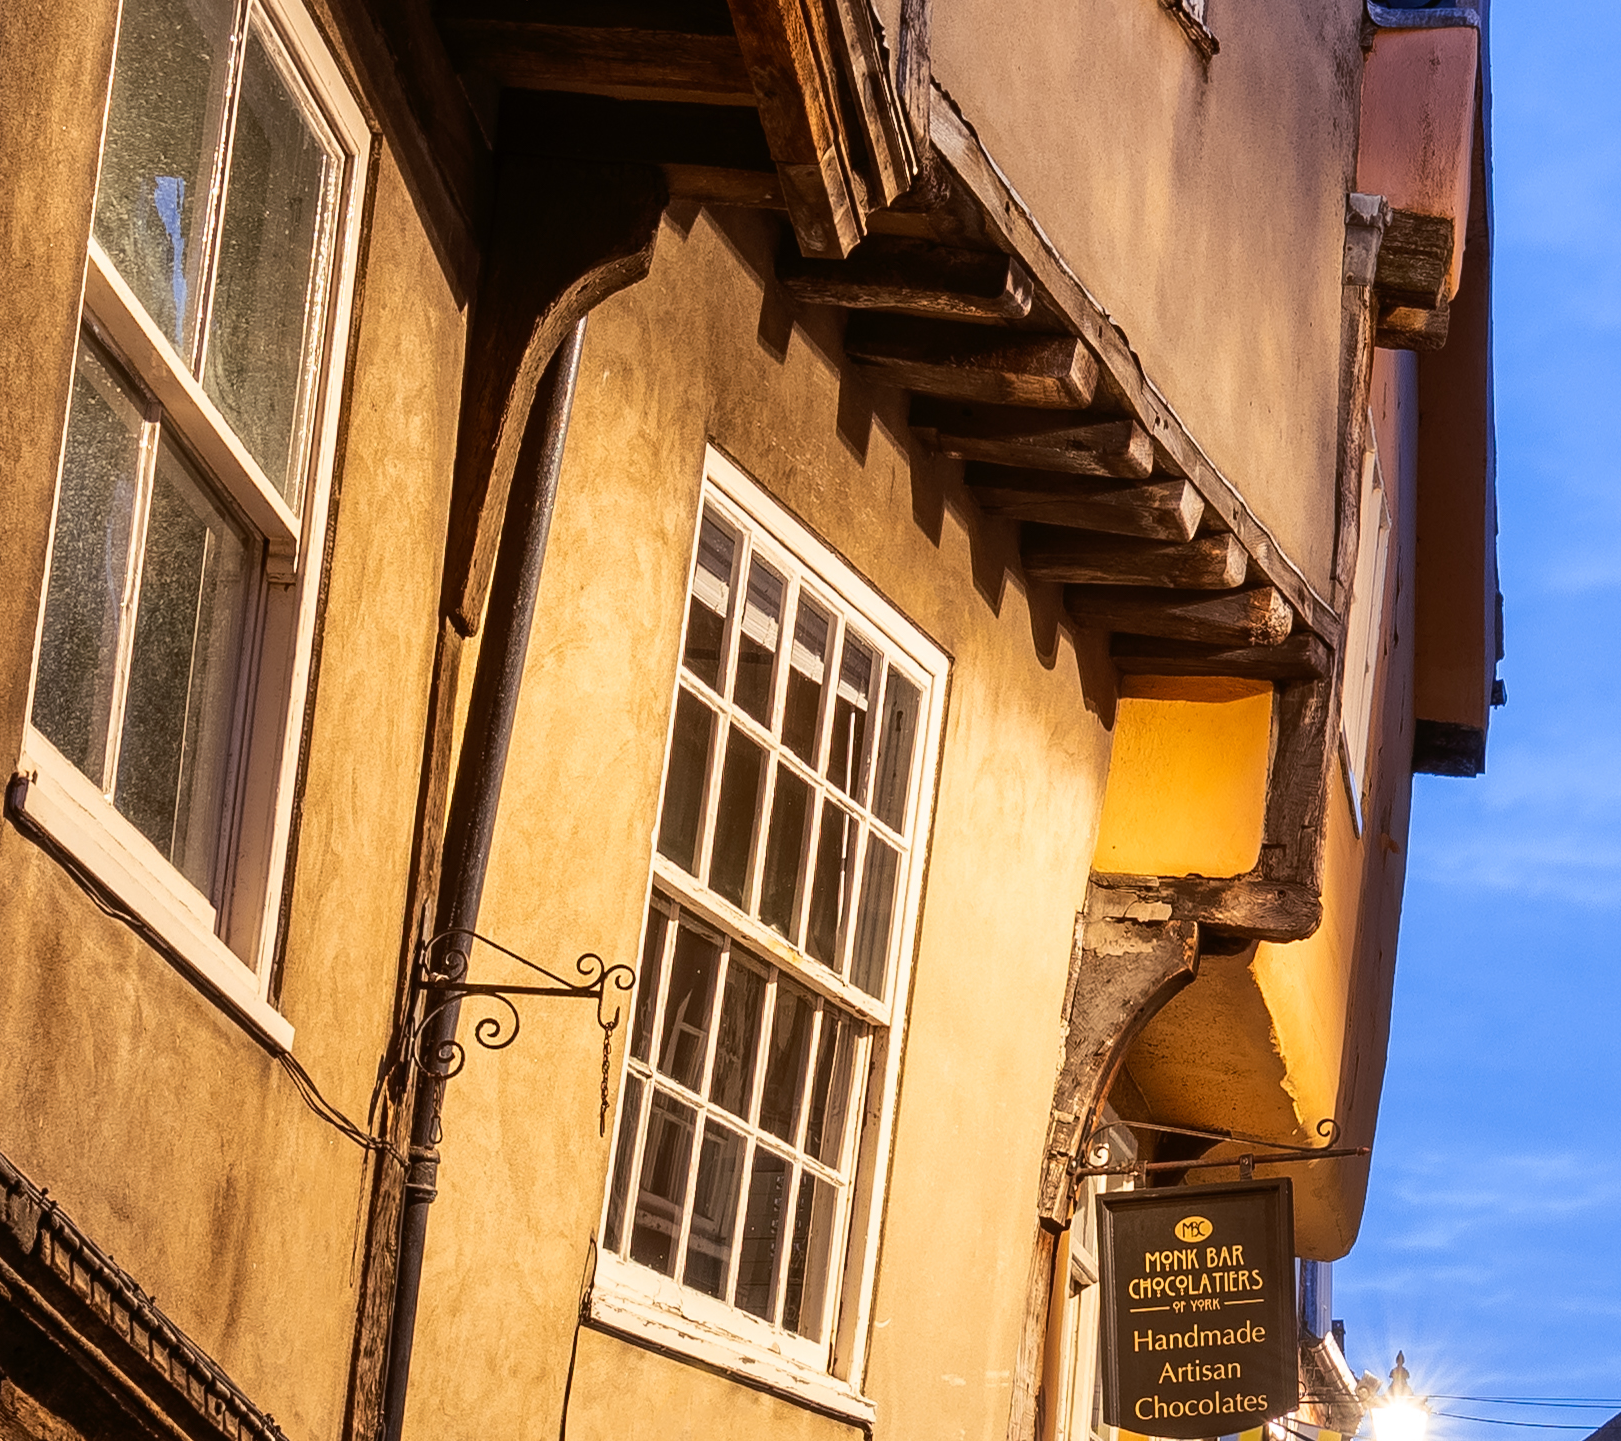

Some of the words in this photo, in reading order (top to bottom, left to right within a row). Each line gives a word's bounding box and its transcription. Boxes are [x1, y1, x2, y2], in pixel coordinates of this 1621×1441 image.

[1145, 1248, 1199, 1273] MONK
[1206, 1245, 1244, 1268] BAR
[1129, 1269, 1263, 1300] CHOCOLATIERS
[1172, 1300, 1186, 1314] OF
[1190, 1298, 1221, 1313] YORK
[1133, 1320, 1266, 1353] Handmade
[1158, 1359, 1241, 1384] Artisan
[1135, 1391, 1268, 1420] Chocolates
